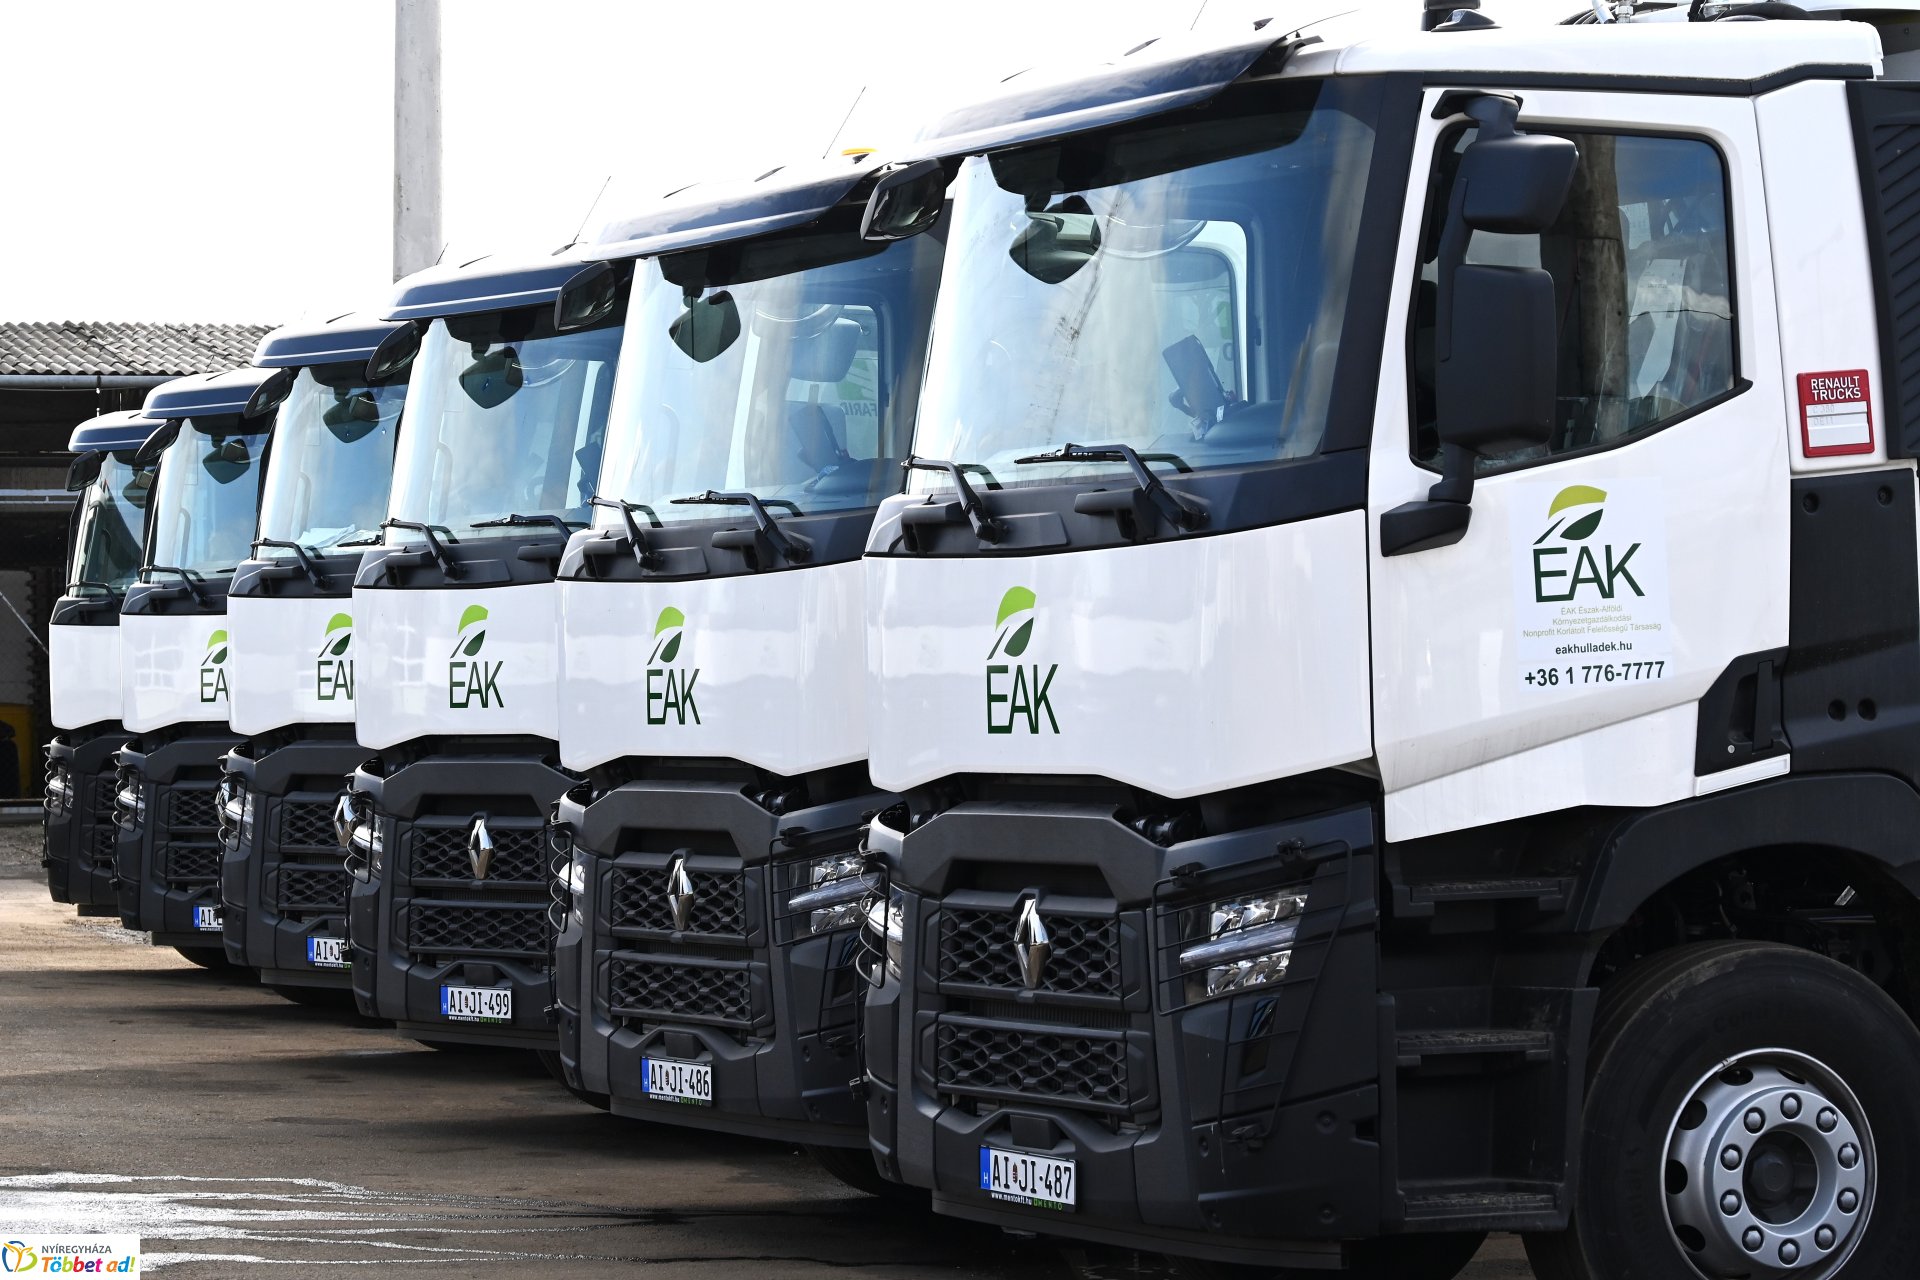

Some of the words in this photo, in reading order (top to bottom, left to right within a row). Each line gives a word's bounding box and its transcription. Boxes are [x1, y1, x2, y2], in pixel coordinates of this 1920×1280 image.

[1811, 376, 1860, 390] RENAULT
[1812, 387, 1861, 401] TRUCKS
[1523, 628, 1555, 638] Nonprofit
[1555, 641, 1633, 655] eakhulladek.hu
[1524, 667, 1559, 687] +36
[1565, 666, 1574, 684] 1
[1581, 660, 1665, 684] 776-7777
